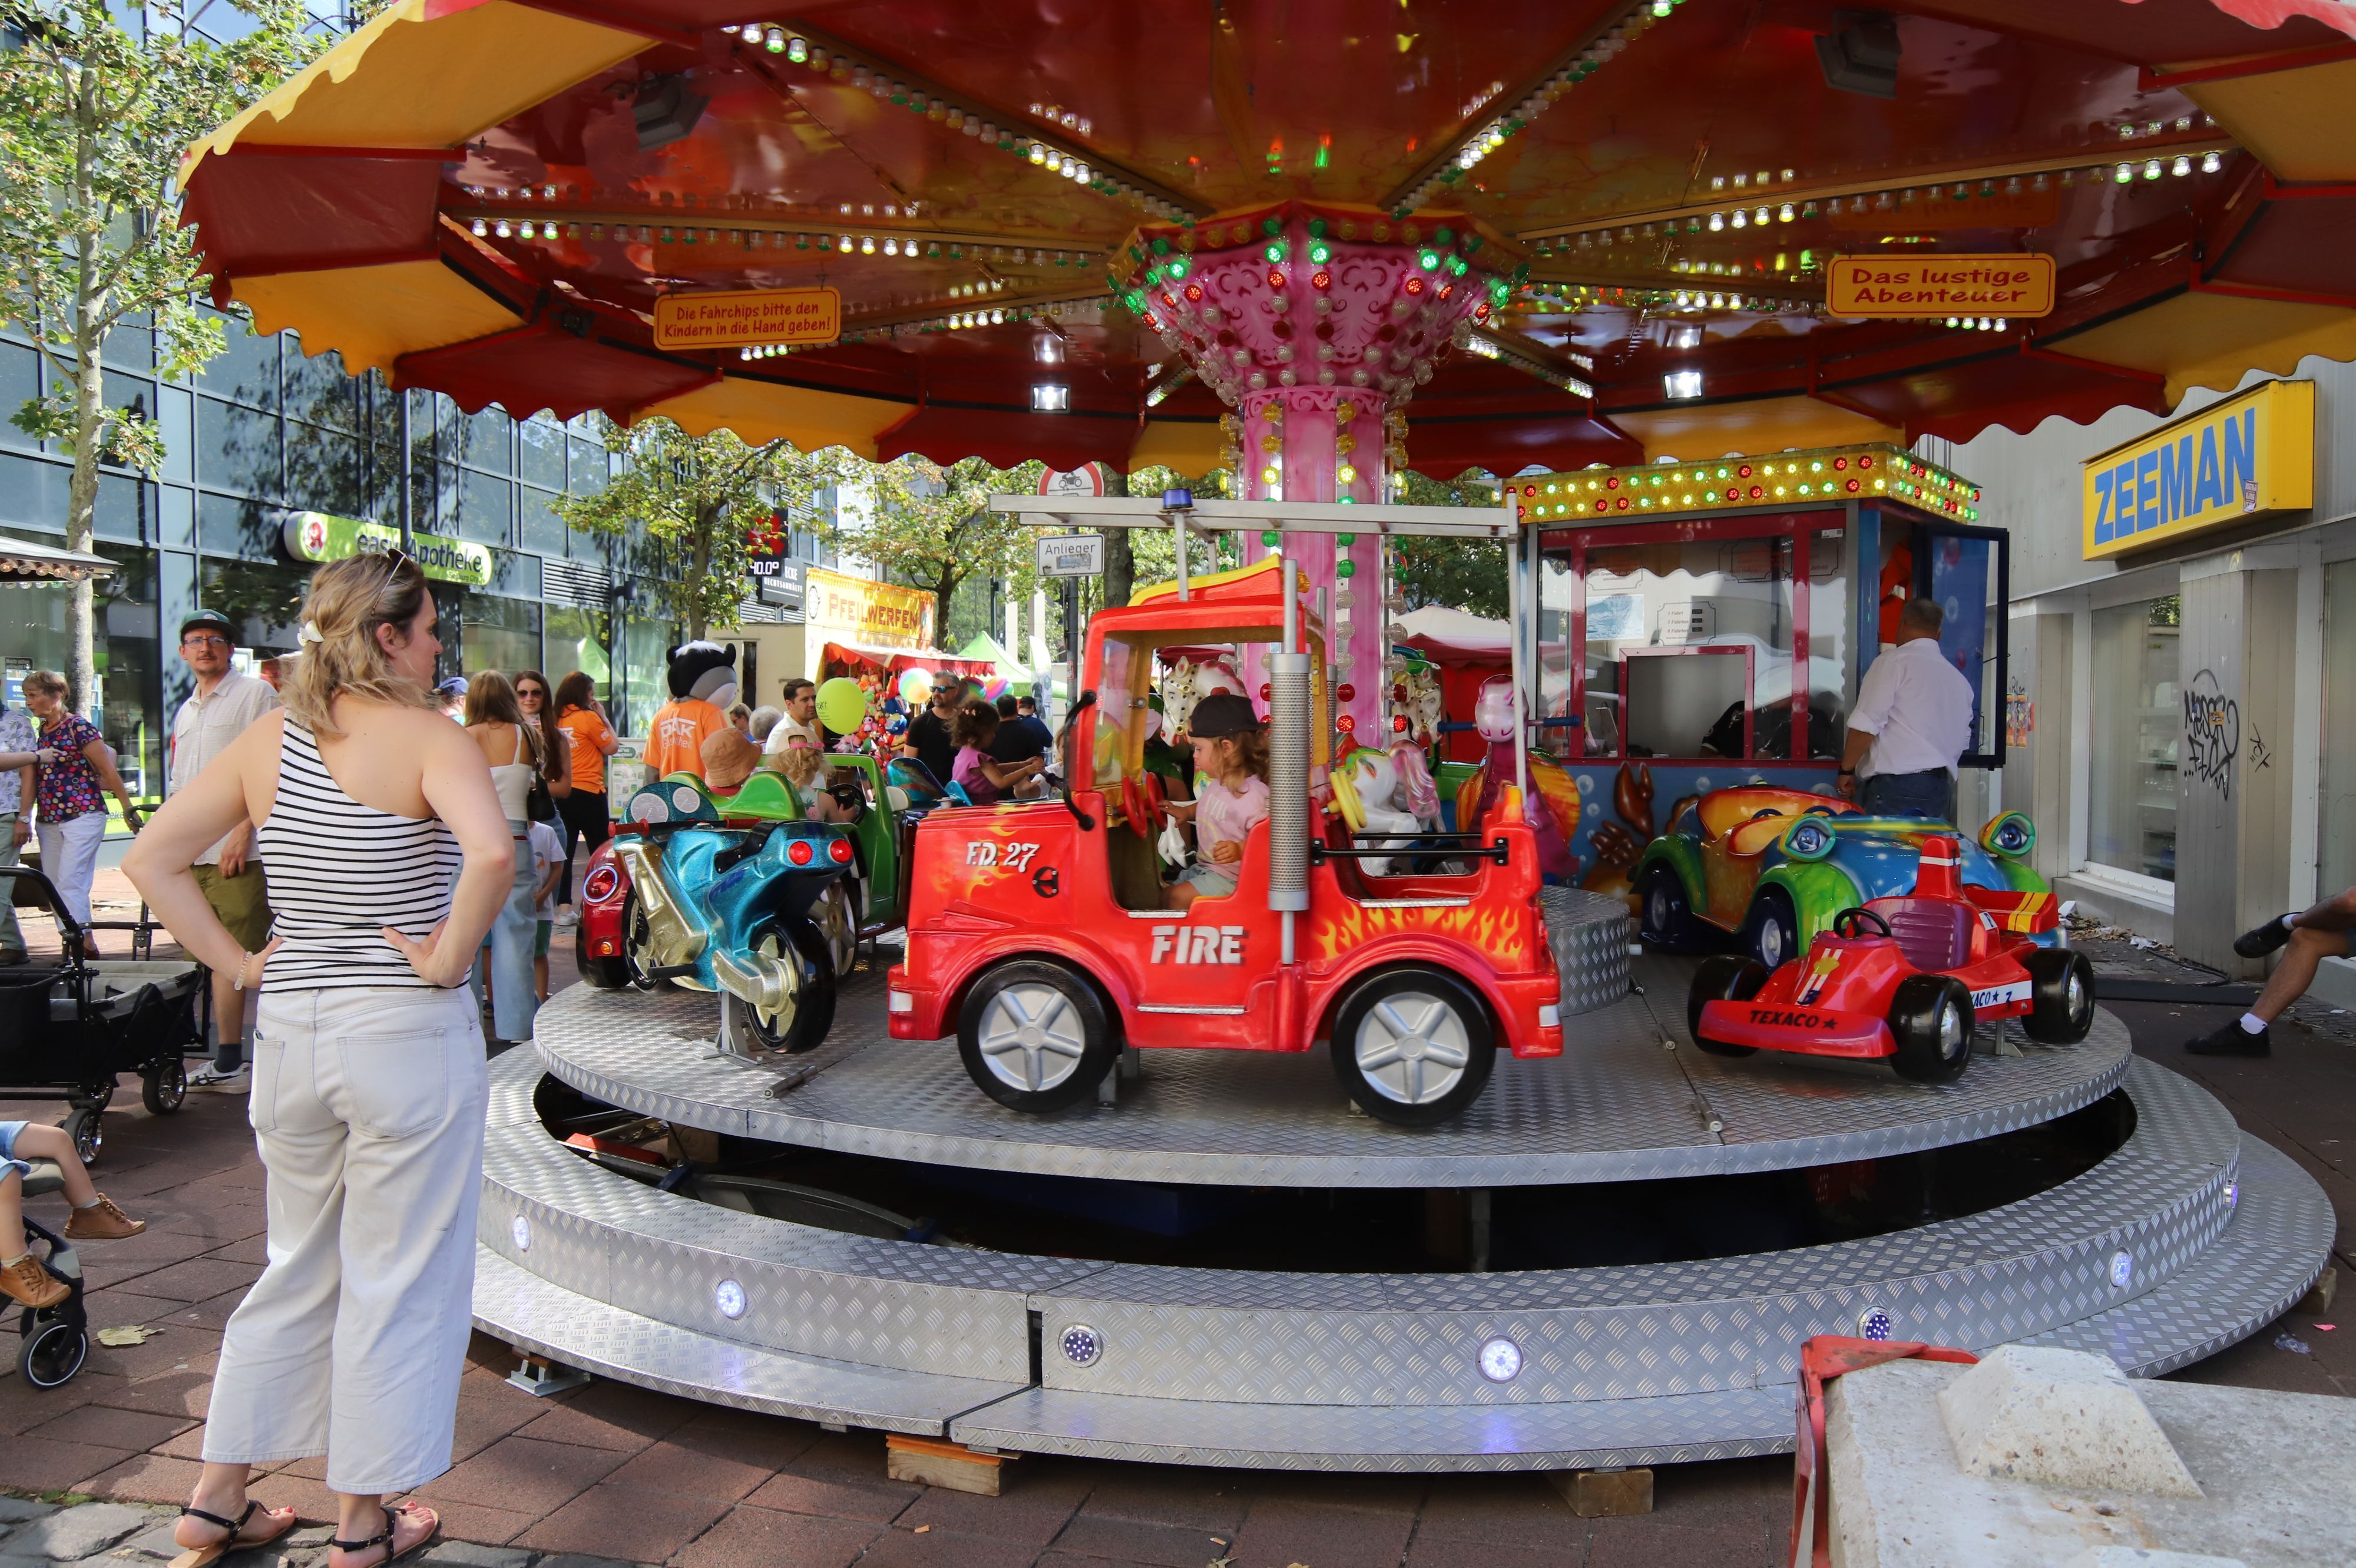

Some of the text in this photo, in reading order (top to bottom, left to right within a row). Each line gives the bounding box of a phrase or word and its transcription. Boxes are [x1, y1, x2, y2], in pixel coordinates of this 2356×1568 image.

[1852, 269, 2031, 287] Das lustige
[1854, 287, 2027, 303] Abenteuer
[677, 302, 819, 320] Die Fahrchips bitte den
[664, 316, 830, 338] Kindern in die Hand geben!
[2094, 406, 2255, 546] ZEEMAN
[411, 538, 482, 573] Apotheke
[1045, 542, 1096, 555] Anlieger
[763, 577, 803, 593] RECHTSANWÄLTE
[829, 593, 918, 629] PFEILWERFEN
[660, 716, 697, 739] DAK
[966, 842, 1040, 873] F.D. 27
[1150, 925, 1244, 964] FIRE
[1971, 991, 1991, 1008] ACO
[1749, 1010, 1819, 1028] TEXACO
